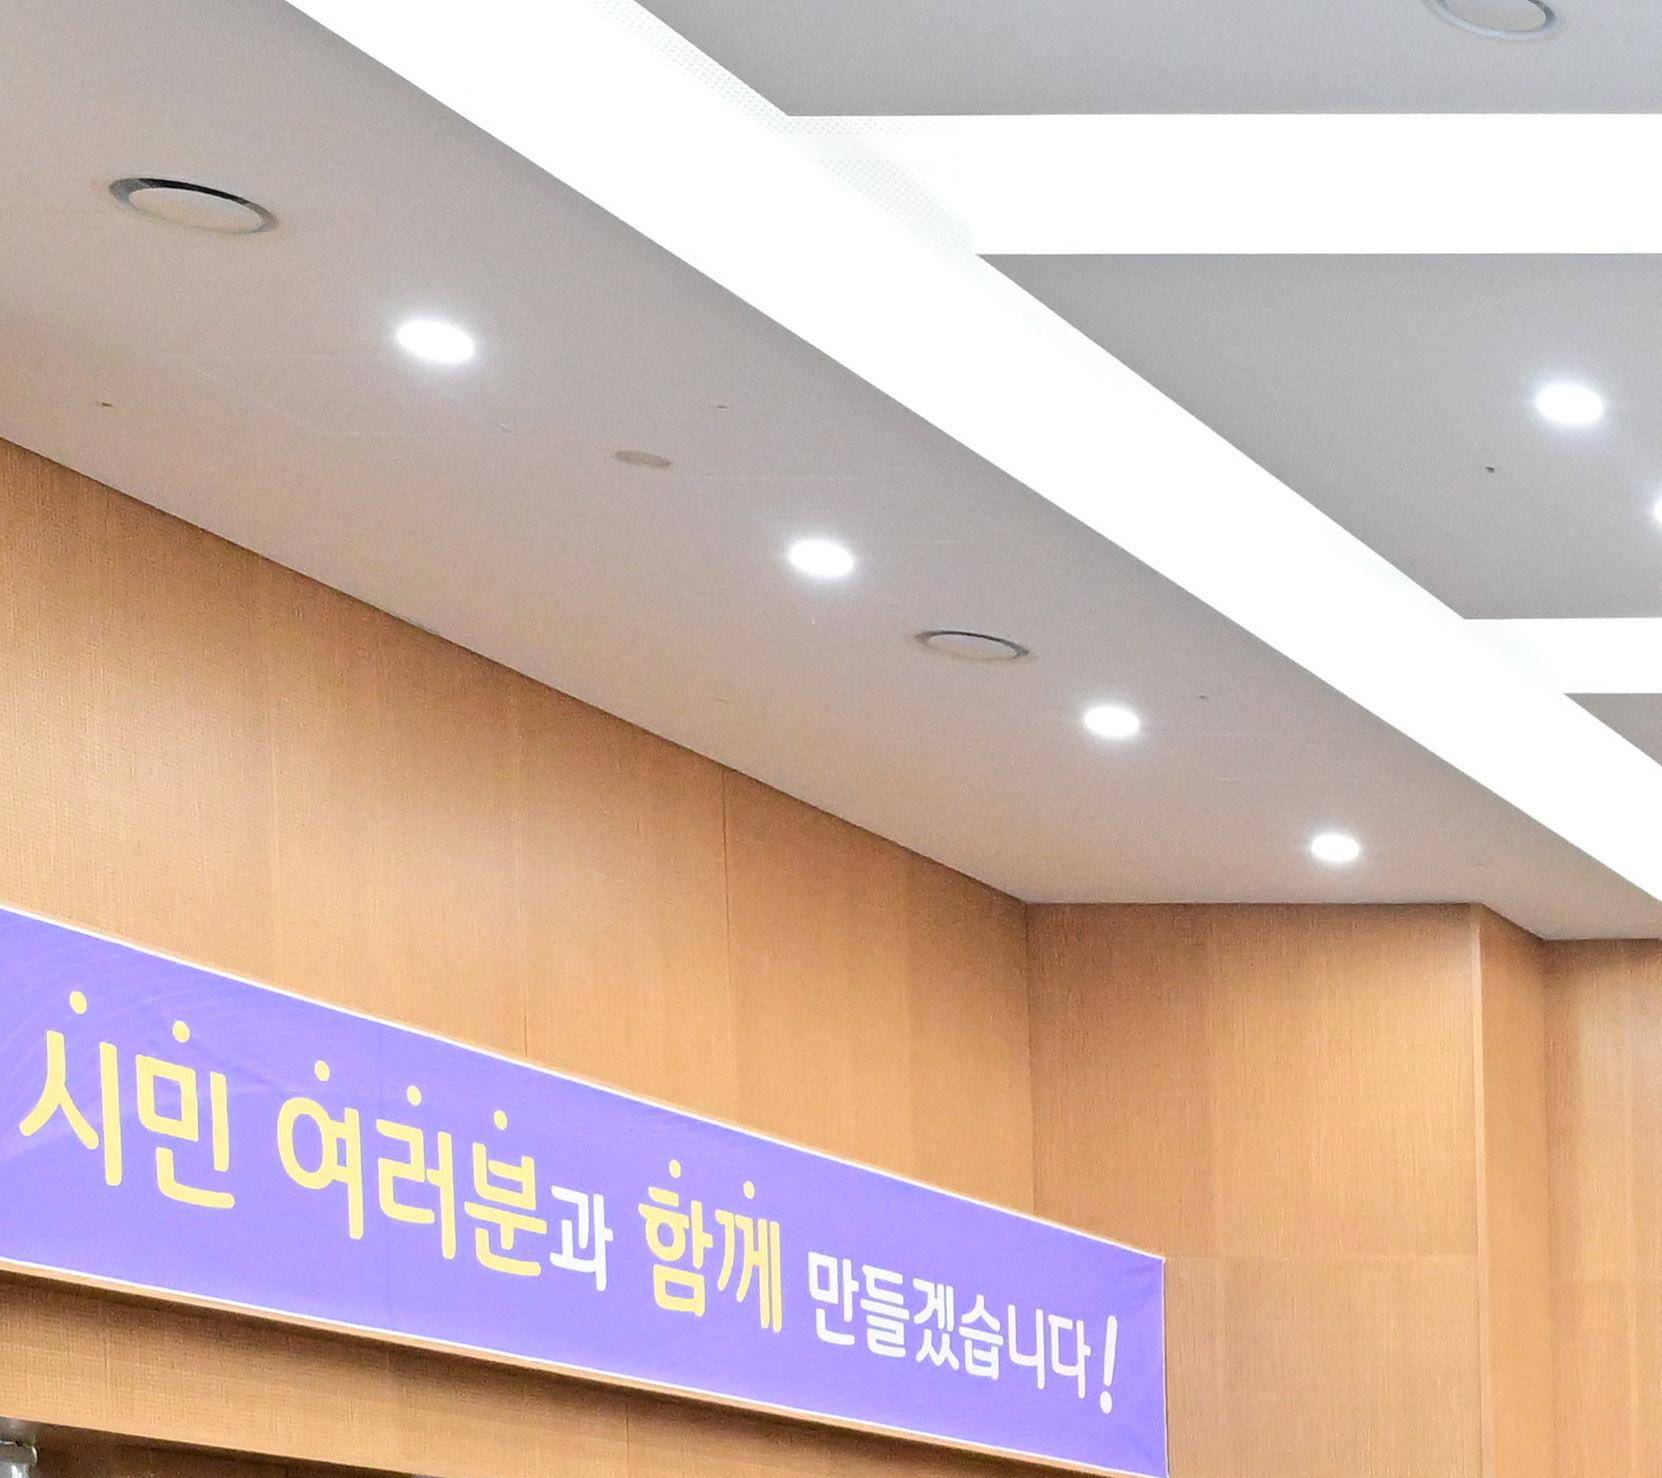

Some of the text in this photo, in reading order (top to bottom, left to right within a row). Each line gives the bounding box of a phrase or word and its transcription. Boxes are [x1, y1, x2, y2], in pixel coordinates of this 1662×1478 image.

[18, 1005, 1119, 1414] 시민 여러분과 함께 만들겠습니다!
